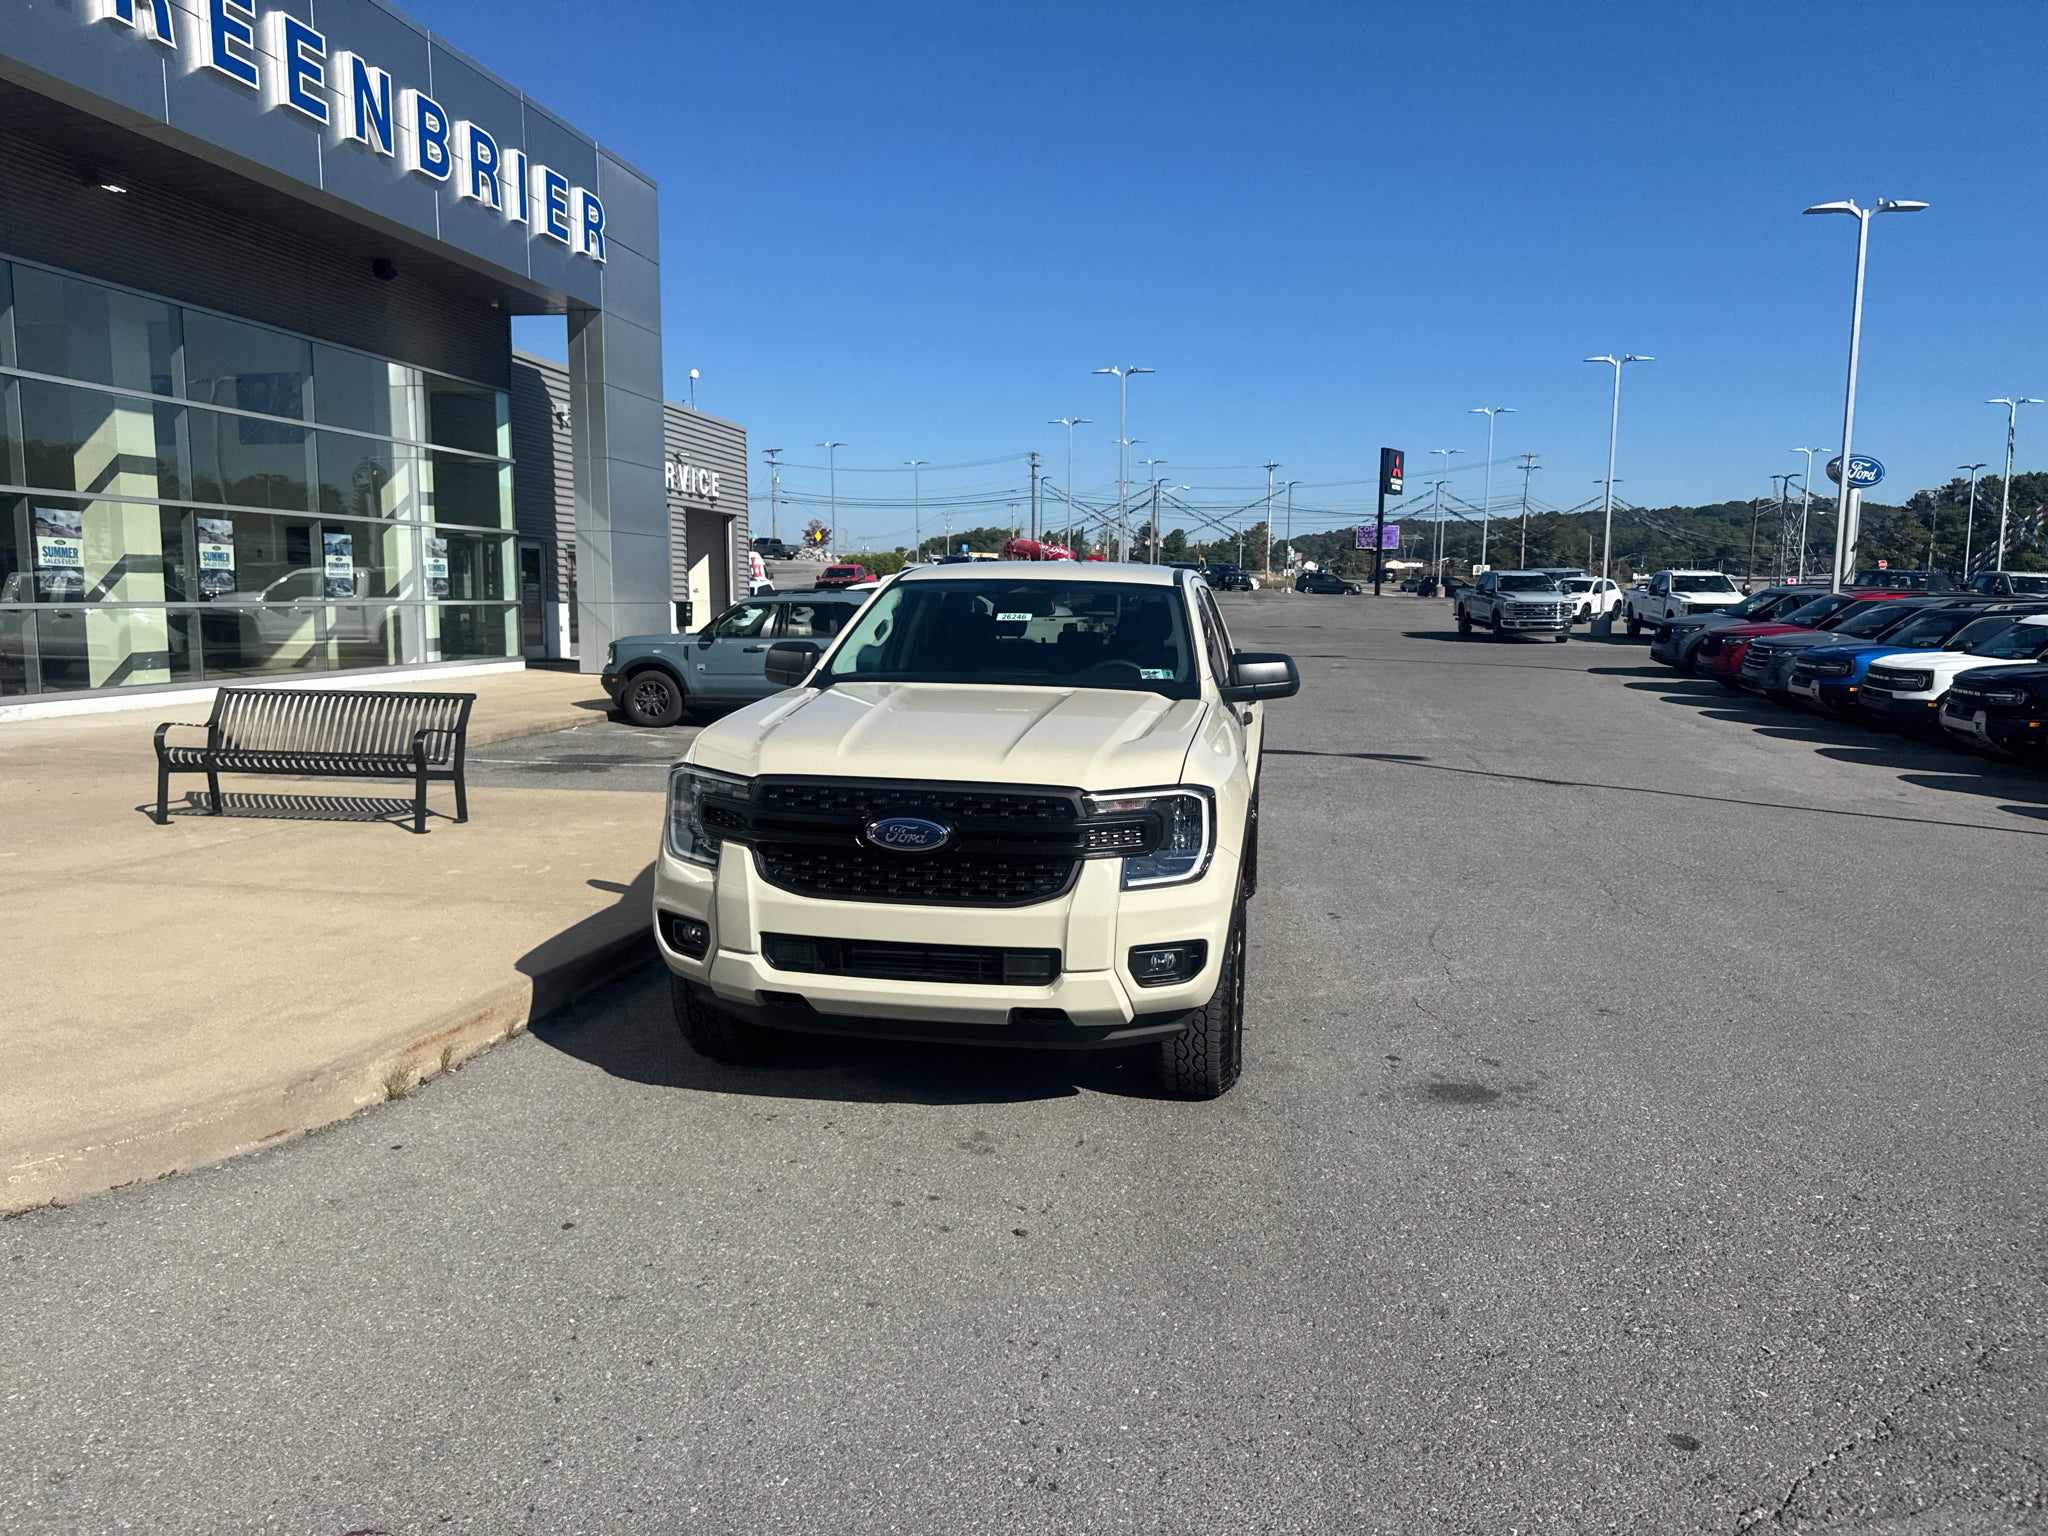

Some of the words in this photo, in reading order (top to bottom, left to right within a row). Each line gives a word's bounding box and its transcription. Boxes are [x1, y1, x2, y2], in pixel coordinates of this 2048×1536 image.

[1848, 460, 1878, 481] Ford
[42, 545, 79, 559] SUMMER
[202, 551, 230, 562] SUMMER
[885, 824, 930, 844] Ford
